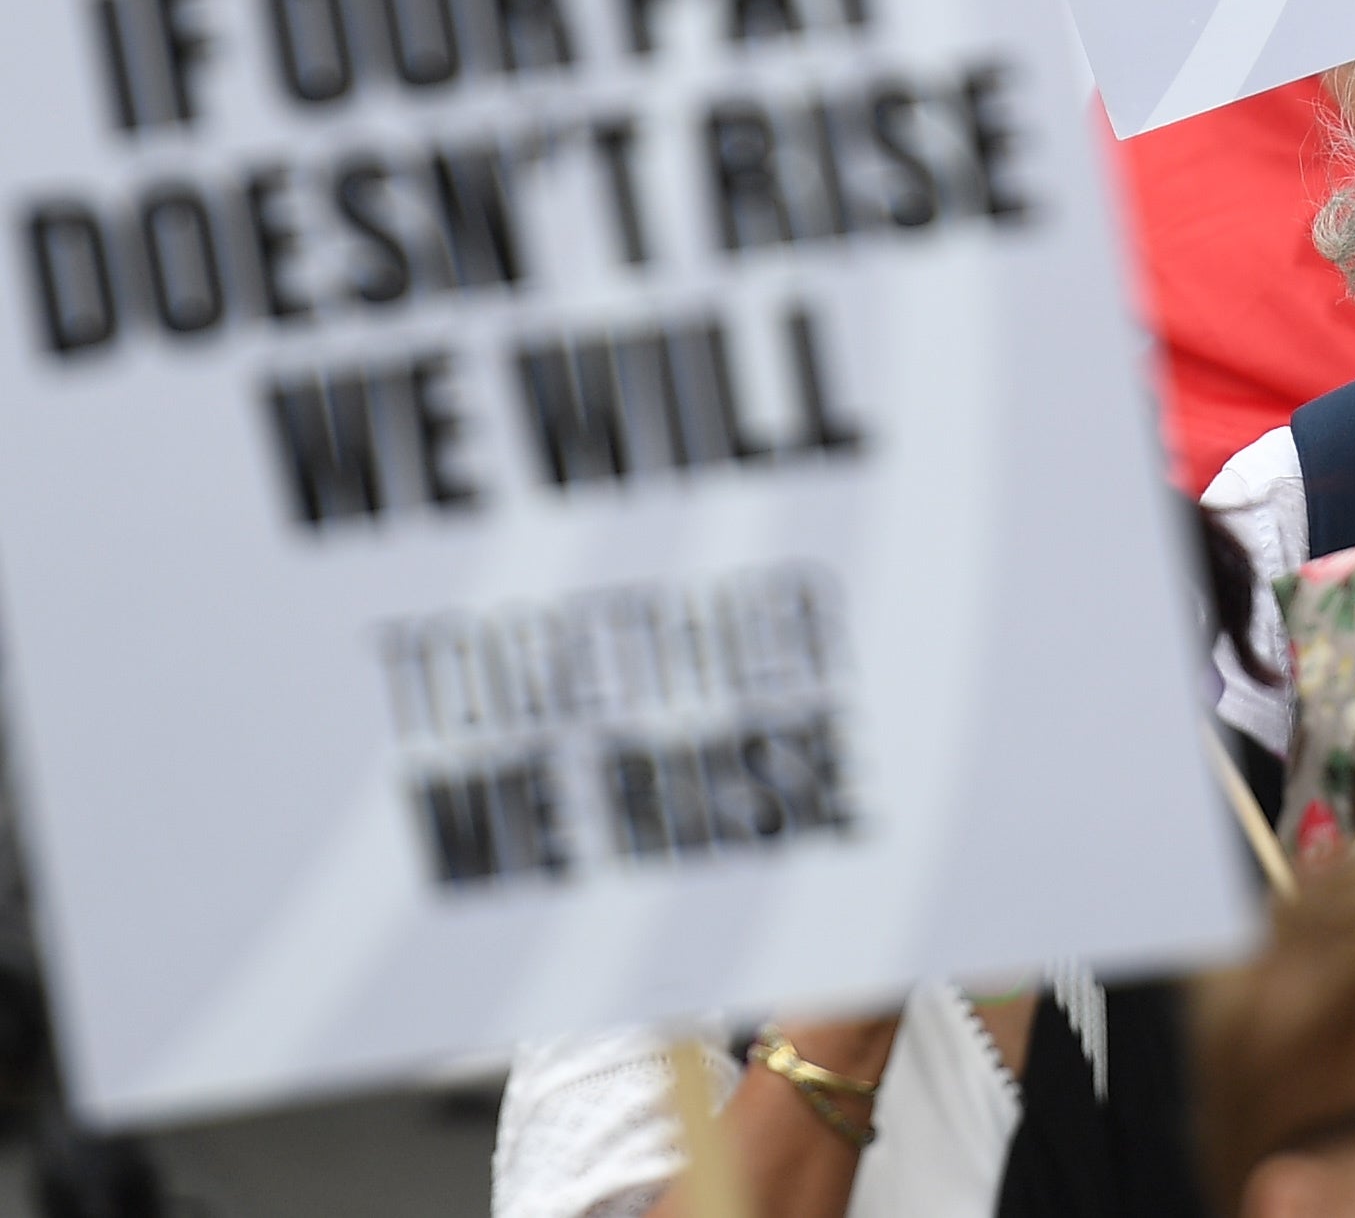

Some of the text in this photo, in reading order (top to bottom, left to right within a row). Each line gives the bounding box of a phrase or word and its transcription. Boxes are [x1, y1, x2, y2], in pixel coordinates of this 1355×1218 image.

[22, 54, 1043, 358] DOESN'T RISE
[262, 302, 872, 539] WE WILL
